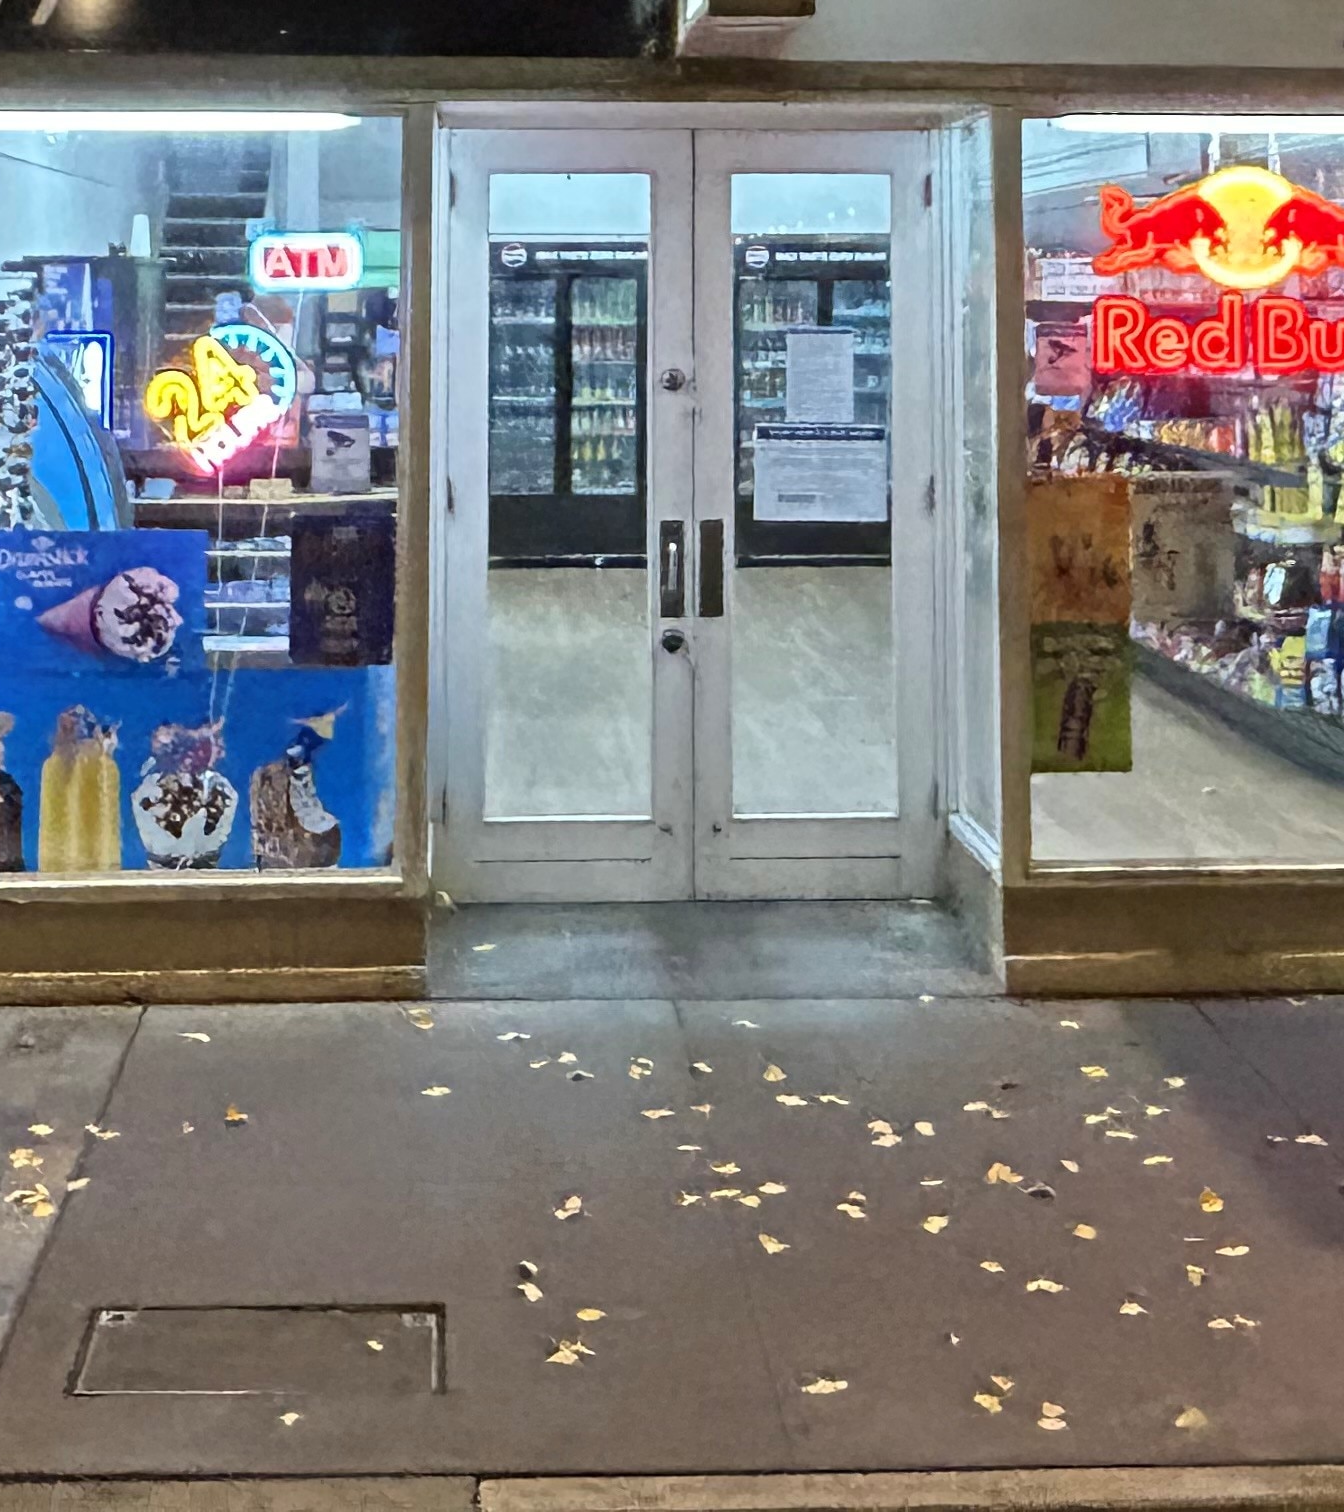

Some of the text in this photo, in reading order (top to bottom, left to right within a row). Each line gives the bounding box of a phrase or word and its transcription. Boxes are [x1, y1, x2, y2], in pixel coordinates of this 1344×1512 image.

[265, 244, 349, 278] ATM
[1093, 289, 1245, 375] Red
[145, 335, 260, 448] 24
